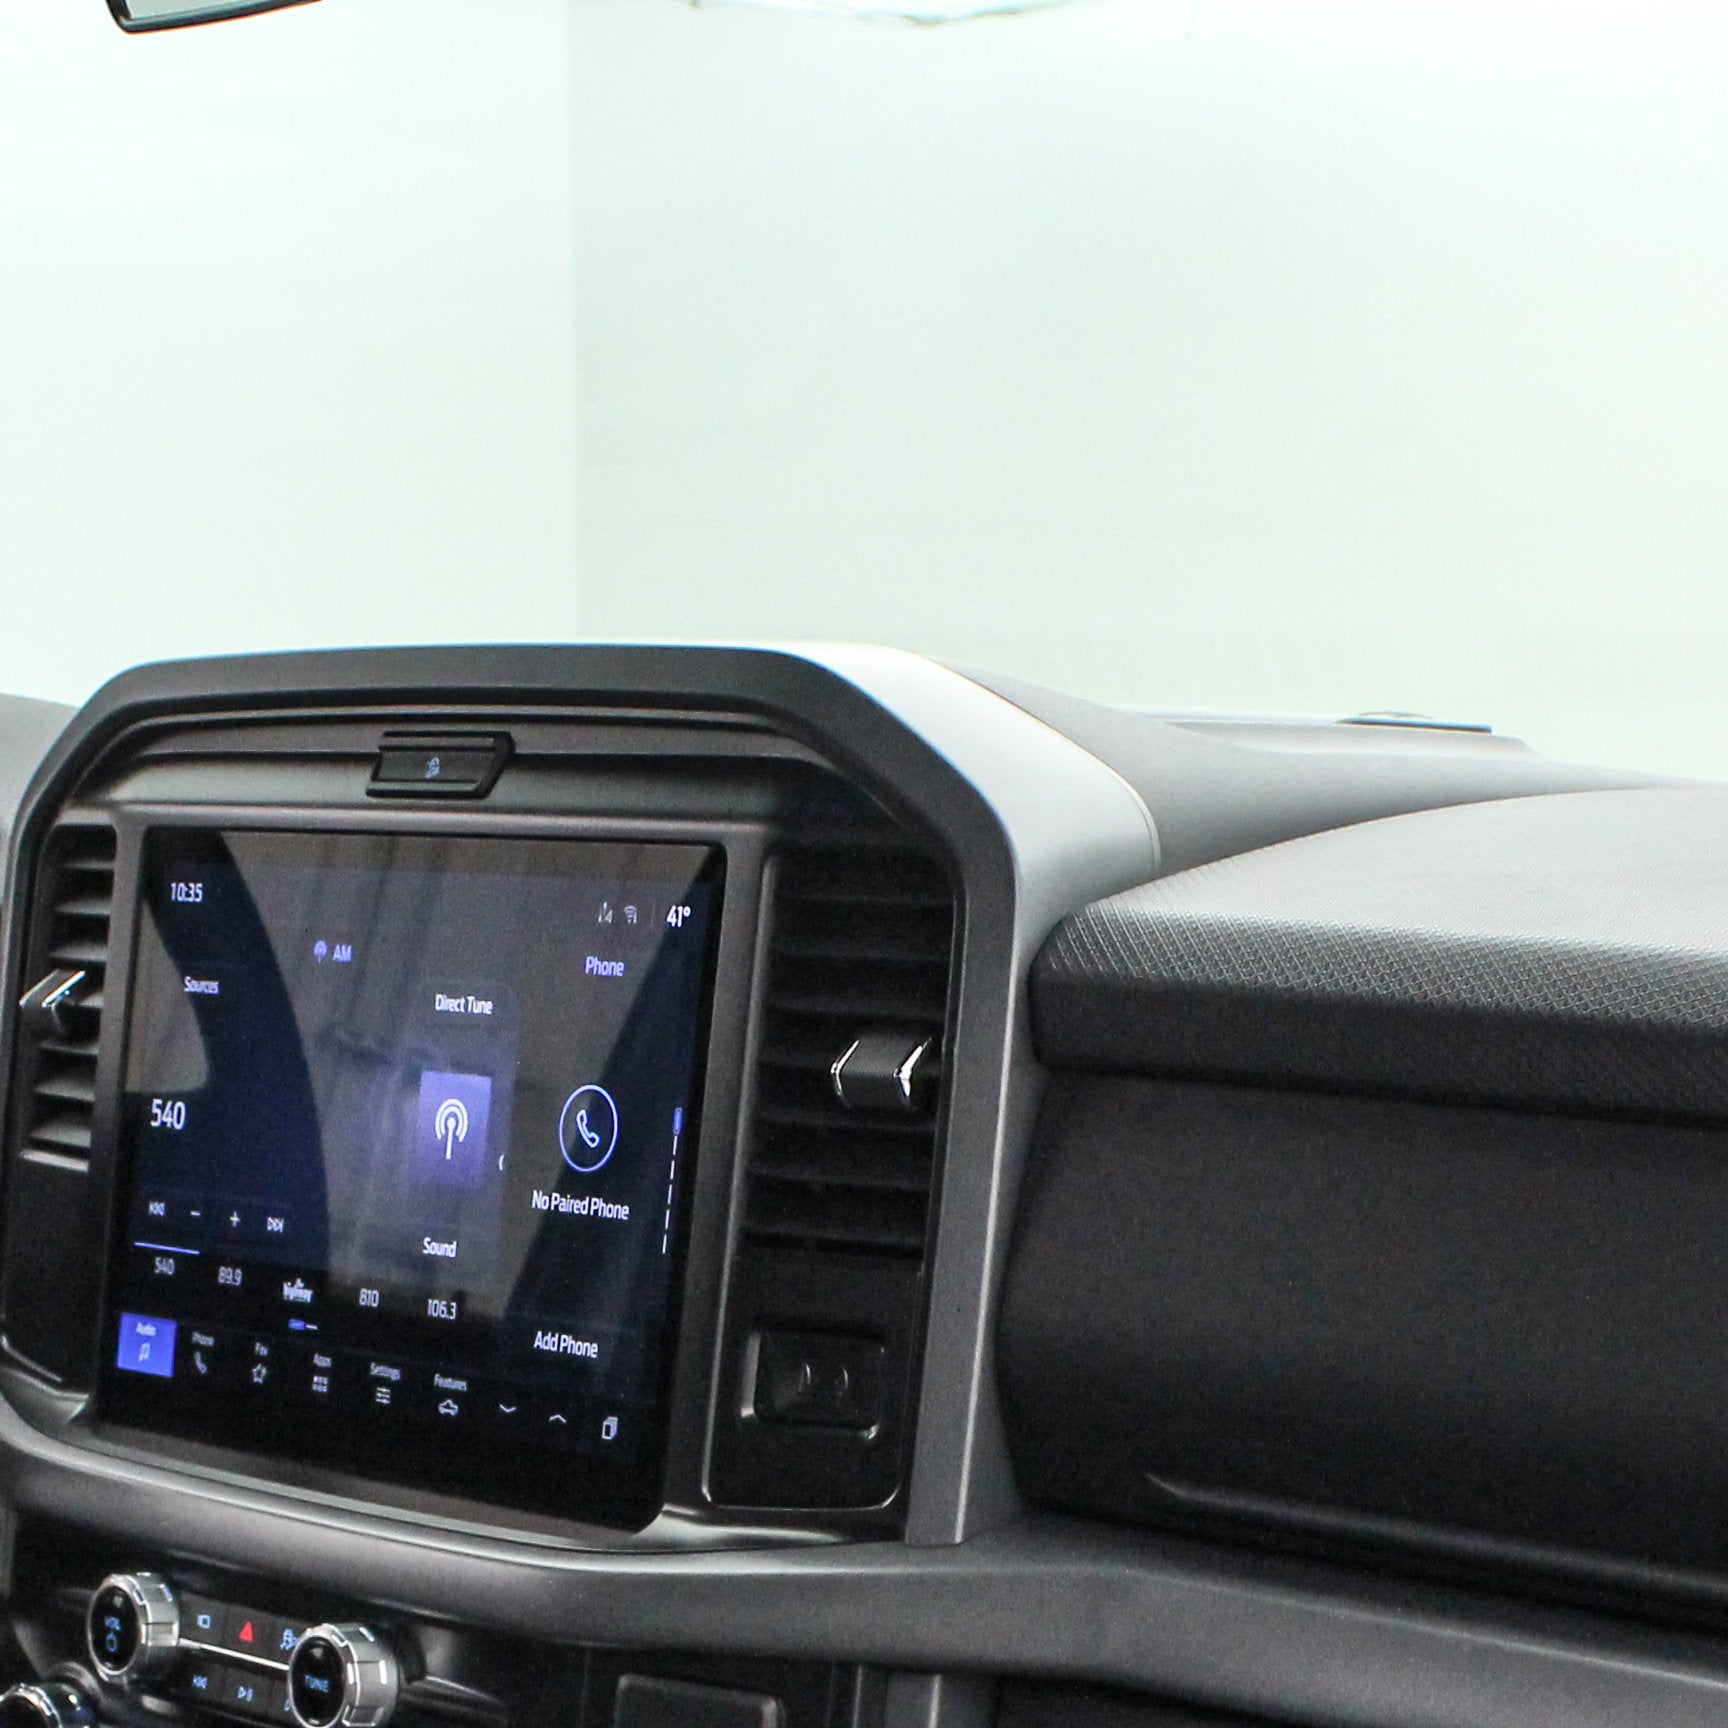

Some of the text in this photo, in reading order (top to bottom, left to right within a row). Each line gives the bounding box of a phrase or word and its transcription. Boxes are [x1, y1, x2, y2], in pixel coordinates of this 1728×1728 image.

[171, 882, 203, 902] 10:35
[332, 944, 353, 962] AM
[585, 956, 625, 977] Phone
[183, 976, 220, 995] Sources
[434, 993, 494, 1015] Direct Tune
[150, 1098, 186, 1130] 540
[531, 1190, 630, 1220] No Paired Phone
[422, 1236, 458, 1258] Sound
[359, 1287, 380, 1308] 810
[427, 1298, 457, 1320] 106.3
[533, 1330, 599, 1358] Add Phone
